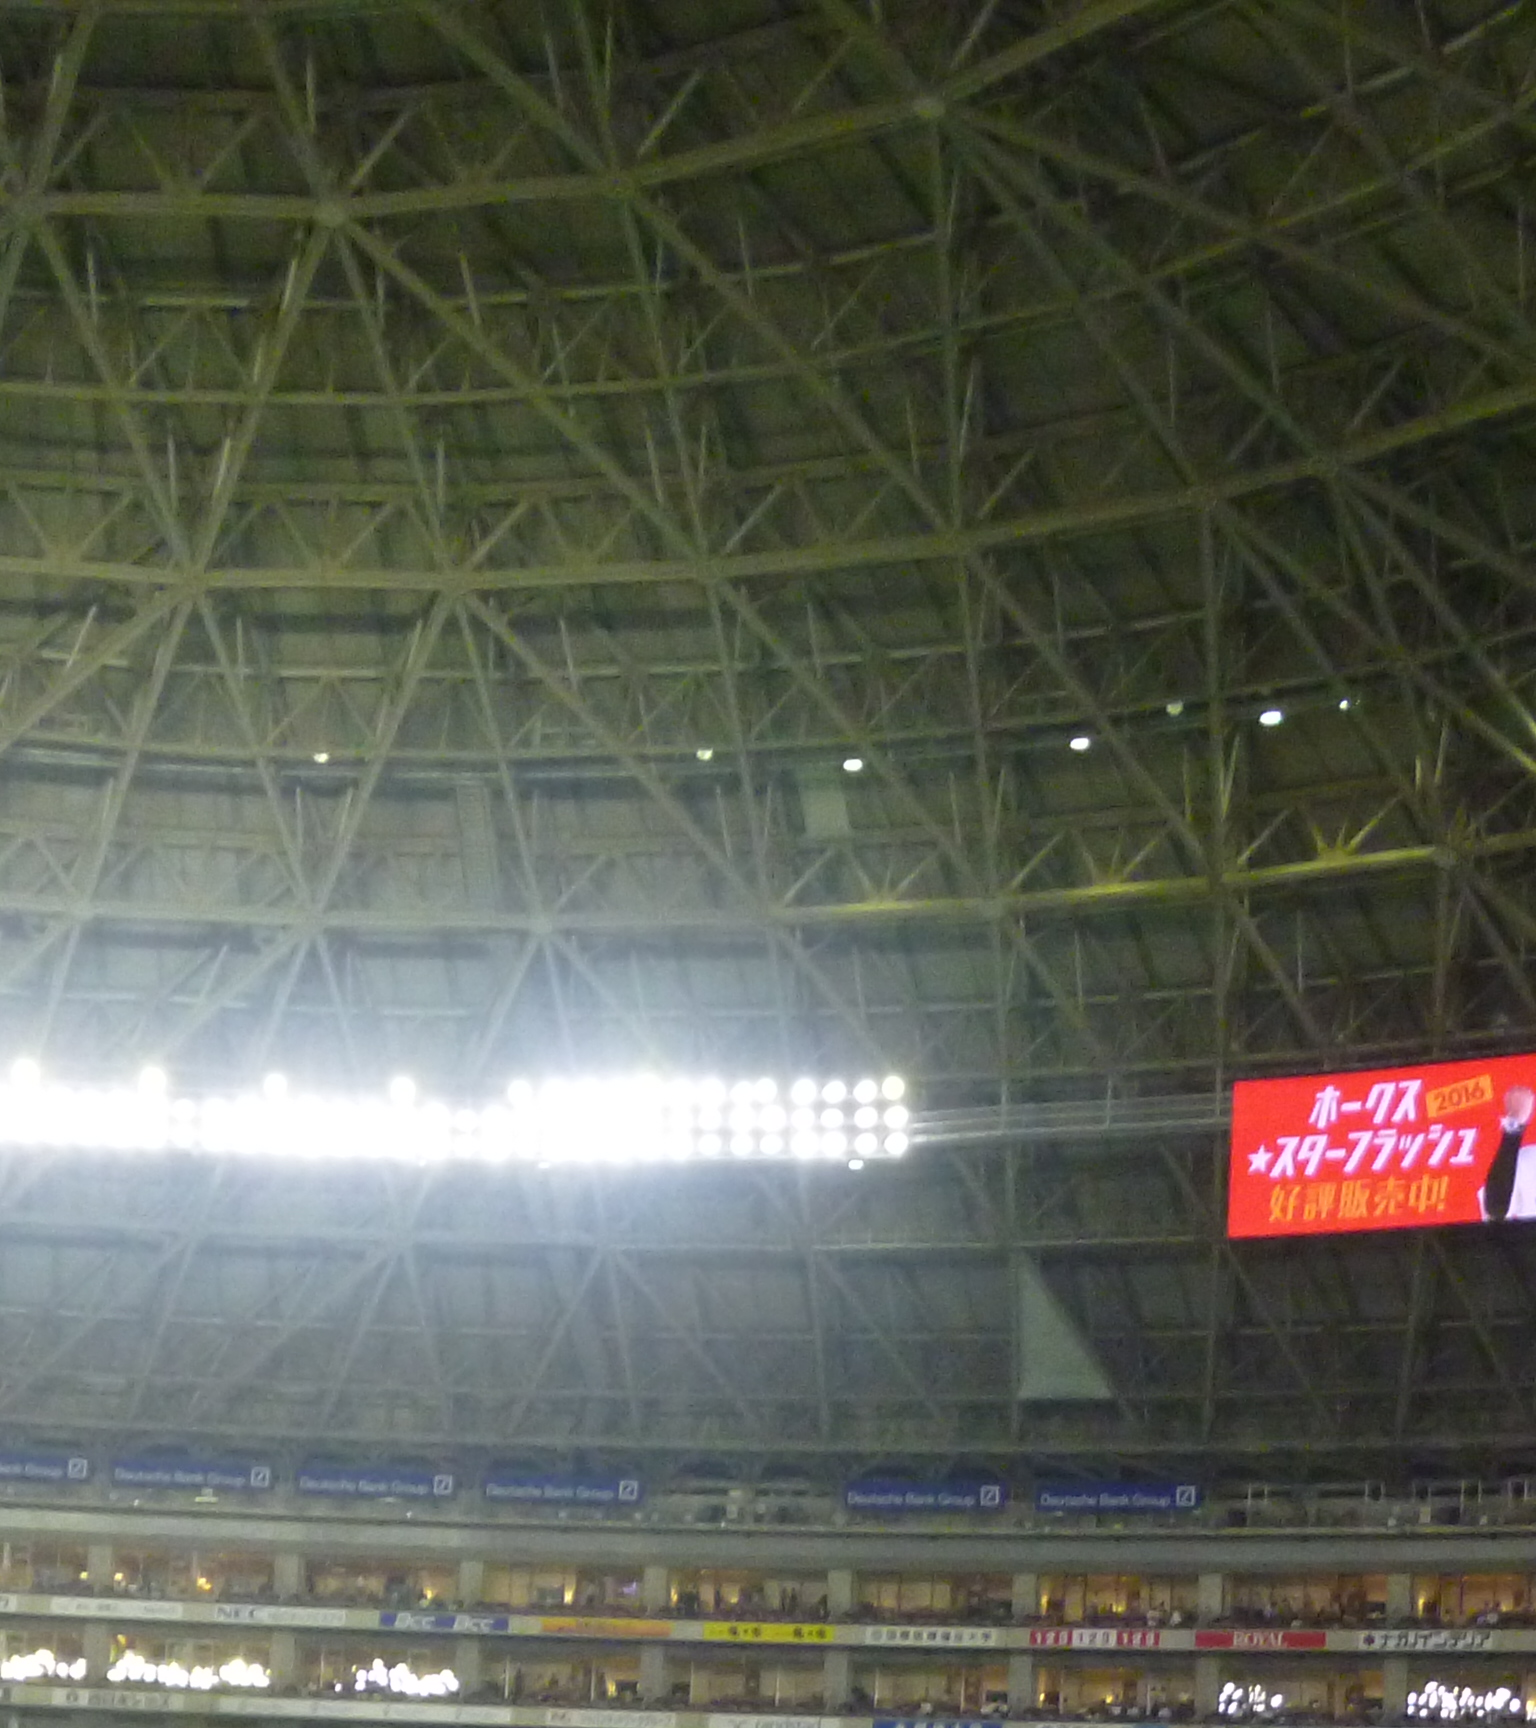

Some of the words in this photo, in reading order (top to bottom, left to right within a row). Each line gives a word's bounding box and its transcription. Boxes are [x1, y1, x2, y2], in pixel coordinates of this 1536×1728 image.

[1309, 1079, 1422, 1129] ホークス
[1433, 1080, 1485, 1114] 2016
[1269, 1124, 1478, 1178] スターフラッシュ
